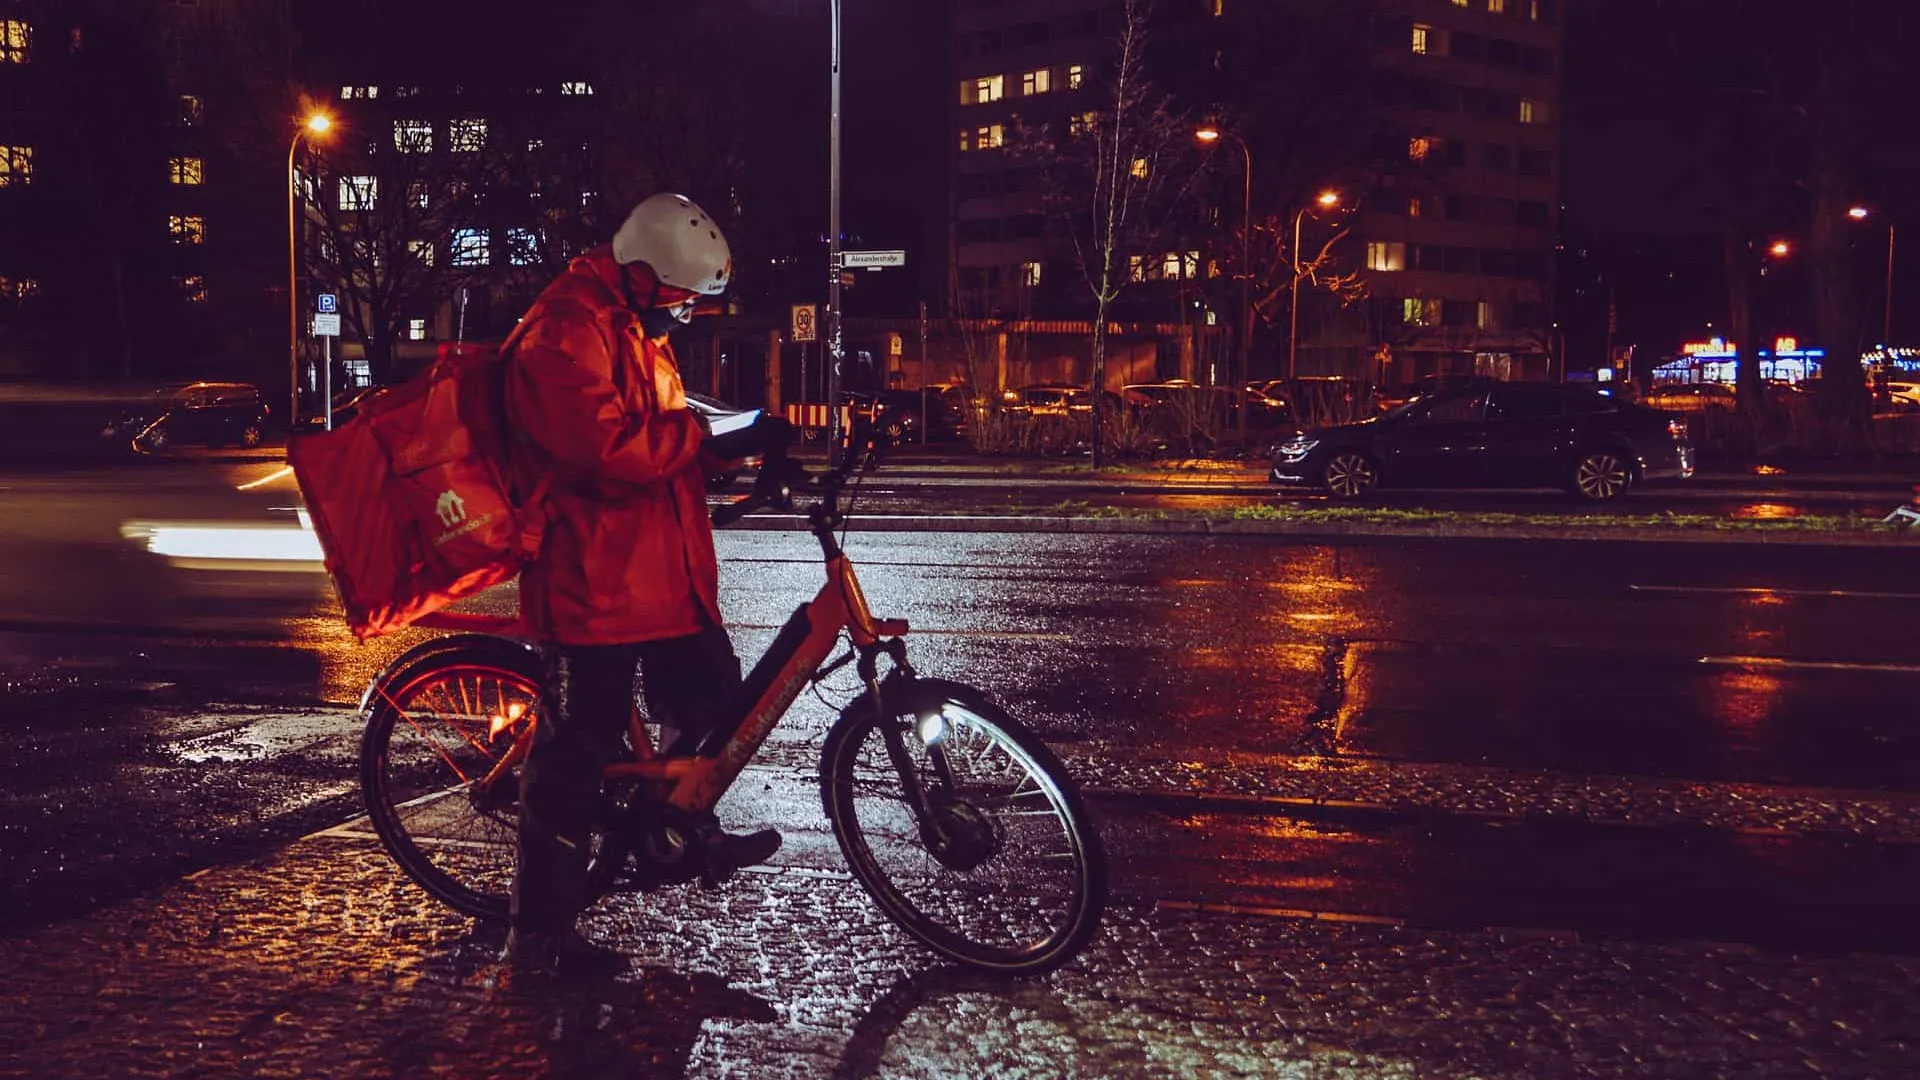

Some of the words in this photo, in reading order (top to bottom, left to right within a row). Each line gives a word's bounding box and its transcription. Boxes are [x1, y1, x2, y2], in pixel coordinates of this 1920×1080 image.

[851, 254, 898, 264] Alexanderstraße
[322, 296, 332, 311] P
[799, 313, 809, 326] 30
